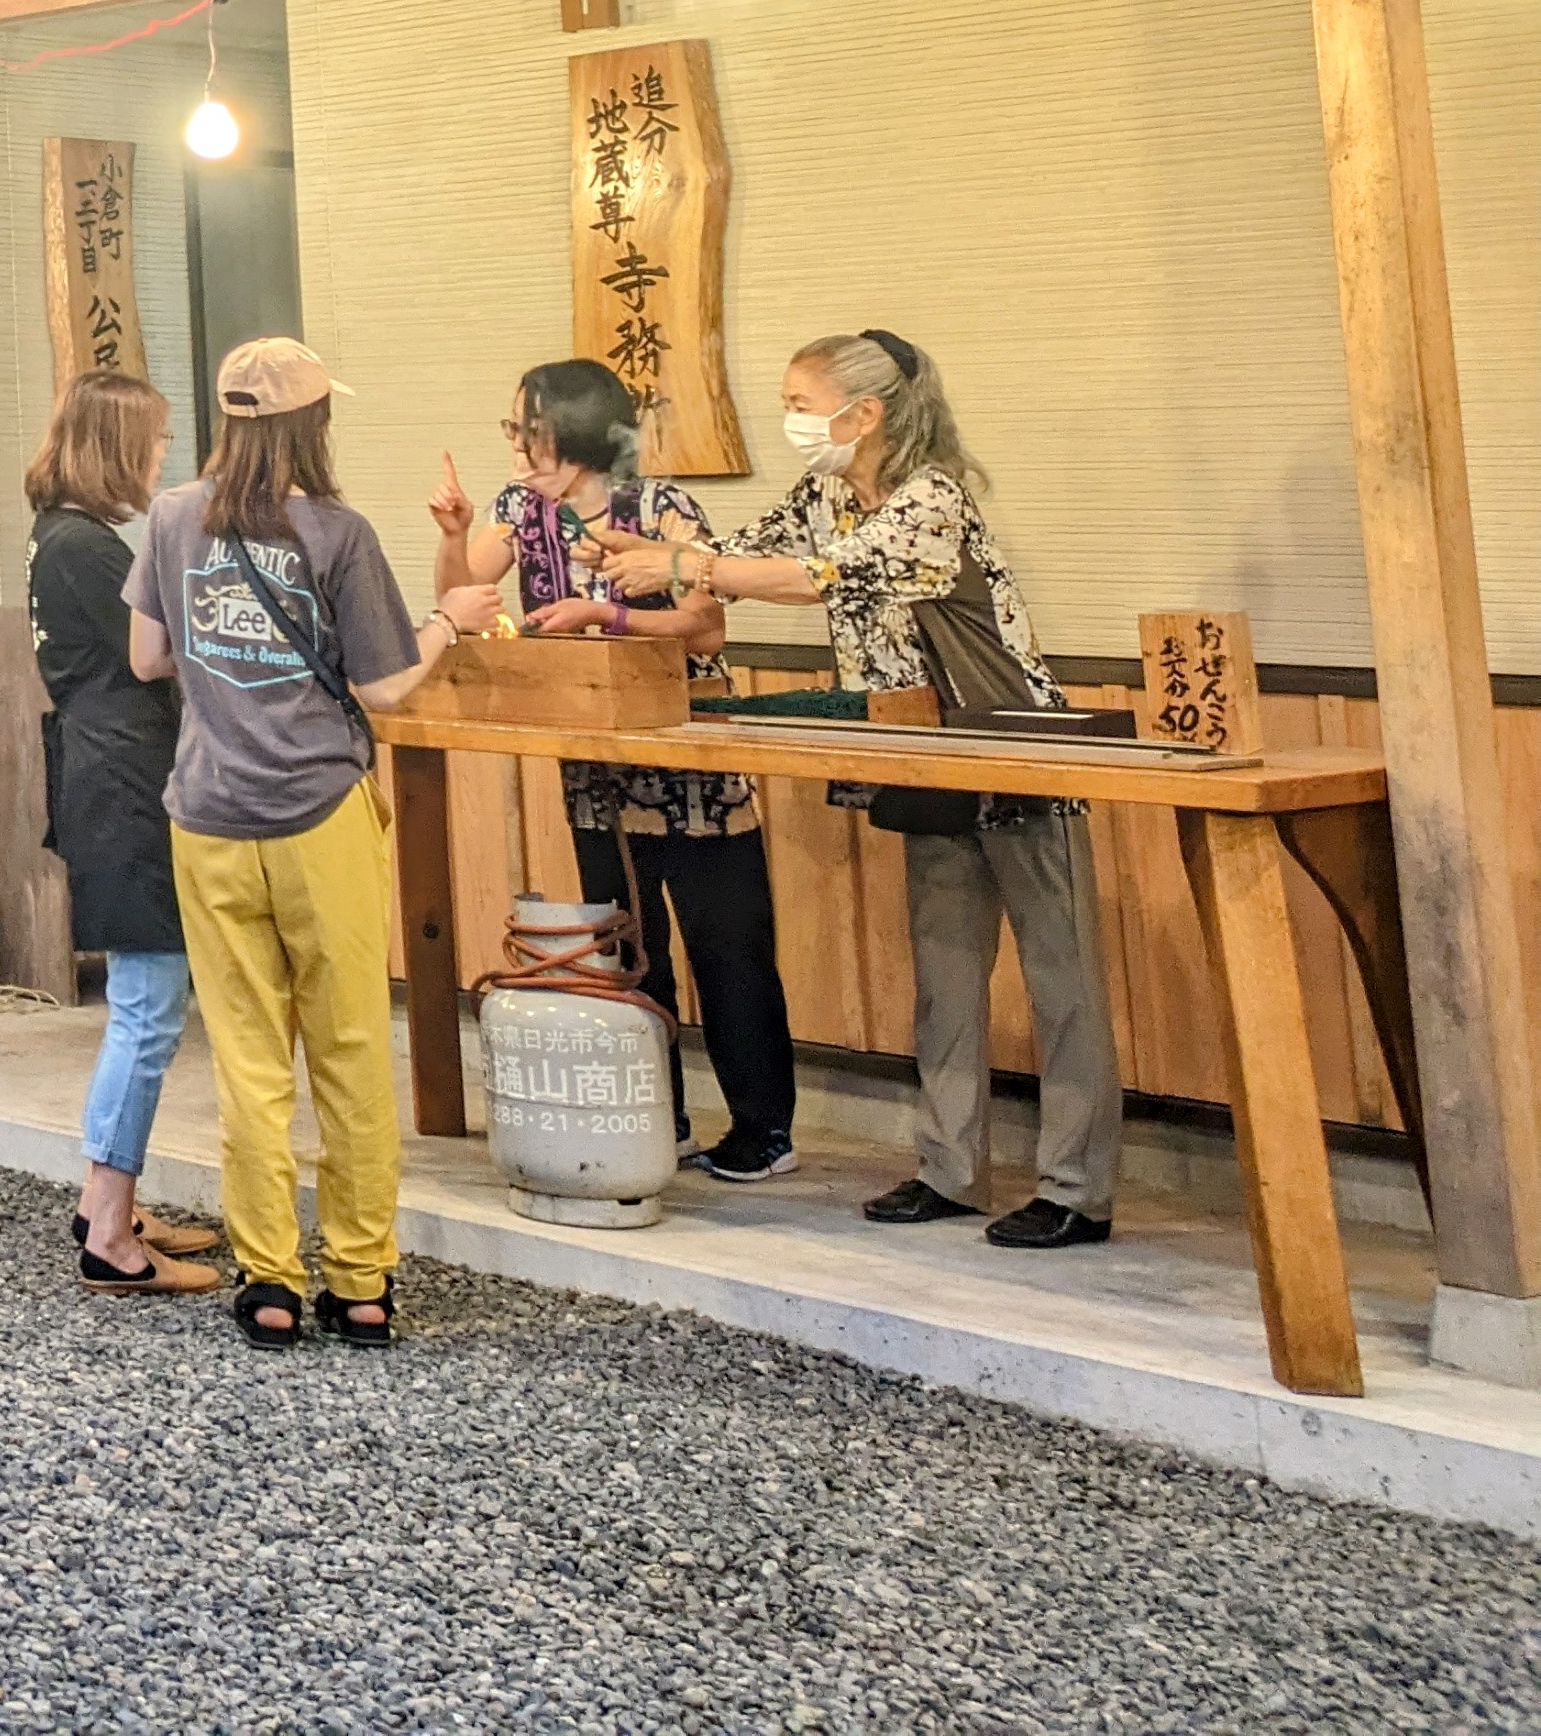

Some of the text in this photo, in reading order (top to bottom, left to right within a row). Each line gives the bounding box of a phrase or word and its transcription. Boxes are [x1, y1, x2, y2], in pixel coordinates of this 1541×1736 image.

[629, 64, 680, 157] 追分
[99, 153, 124, 261] 小倉町
[586, 88, 635, 245] 地蔵尊
[204, 536, 301, 586] AUENTIC
[222, 603, 266, 634] Lee
